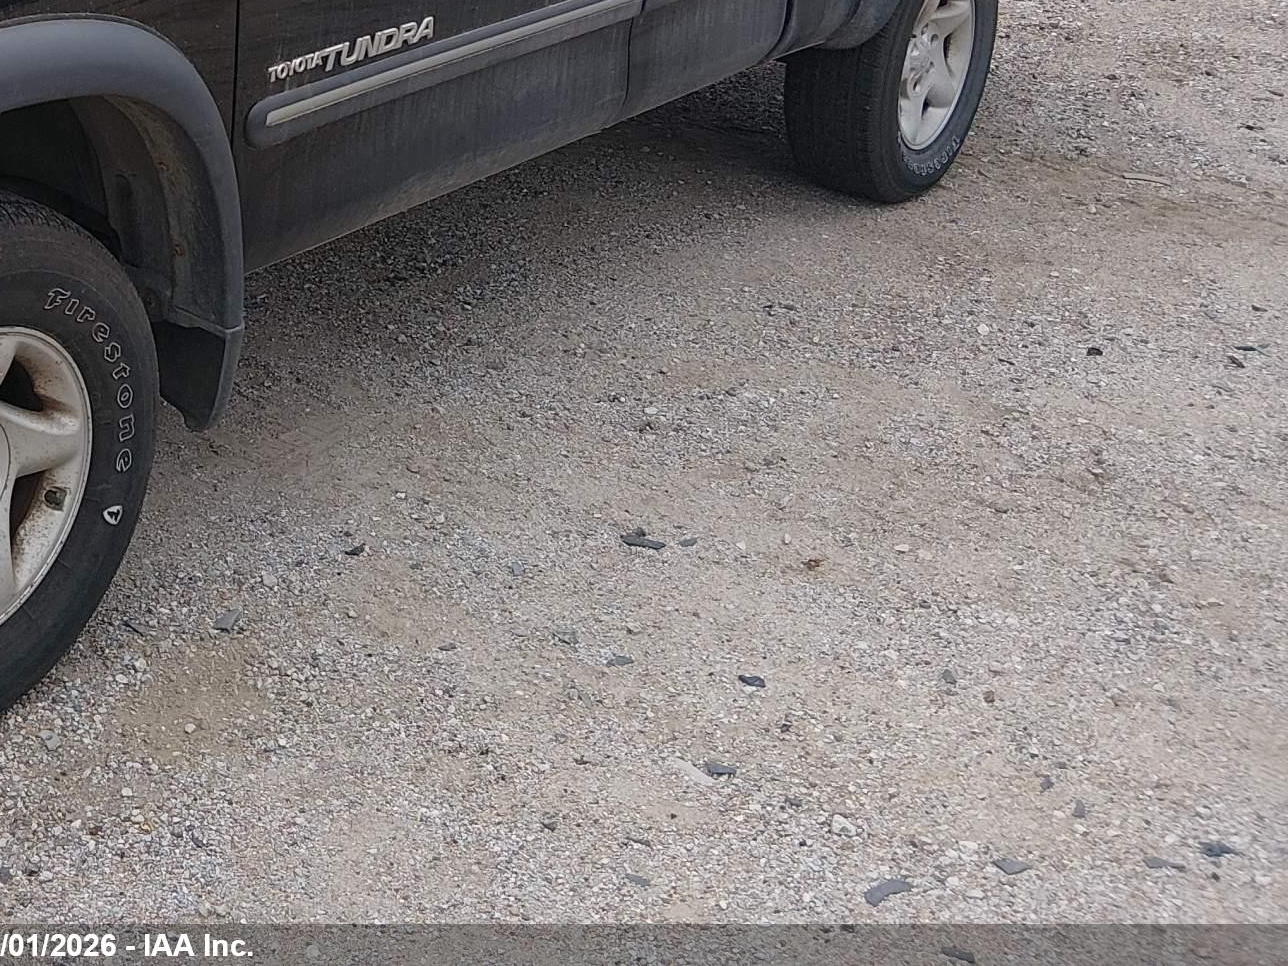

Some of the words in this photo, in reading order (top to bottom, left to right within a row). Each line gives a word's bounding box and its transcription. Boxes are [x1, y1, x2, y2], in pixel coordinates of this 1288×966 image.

[267, 52, 324, 83] TOYOTA
[323, 16, 434, 72] TUNDRA
[43, 287, 137, 473] Firestone
